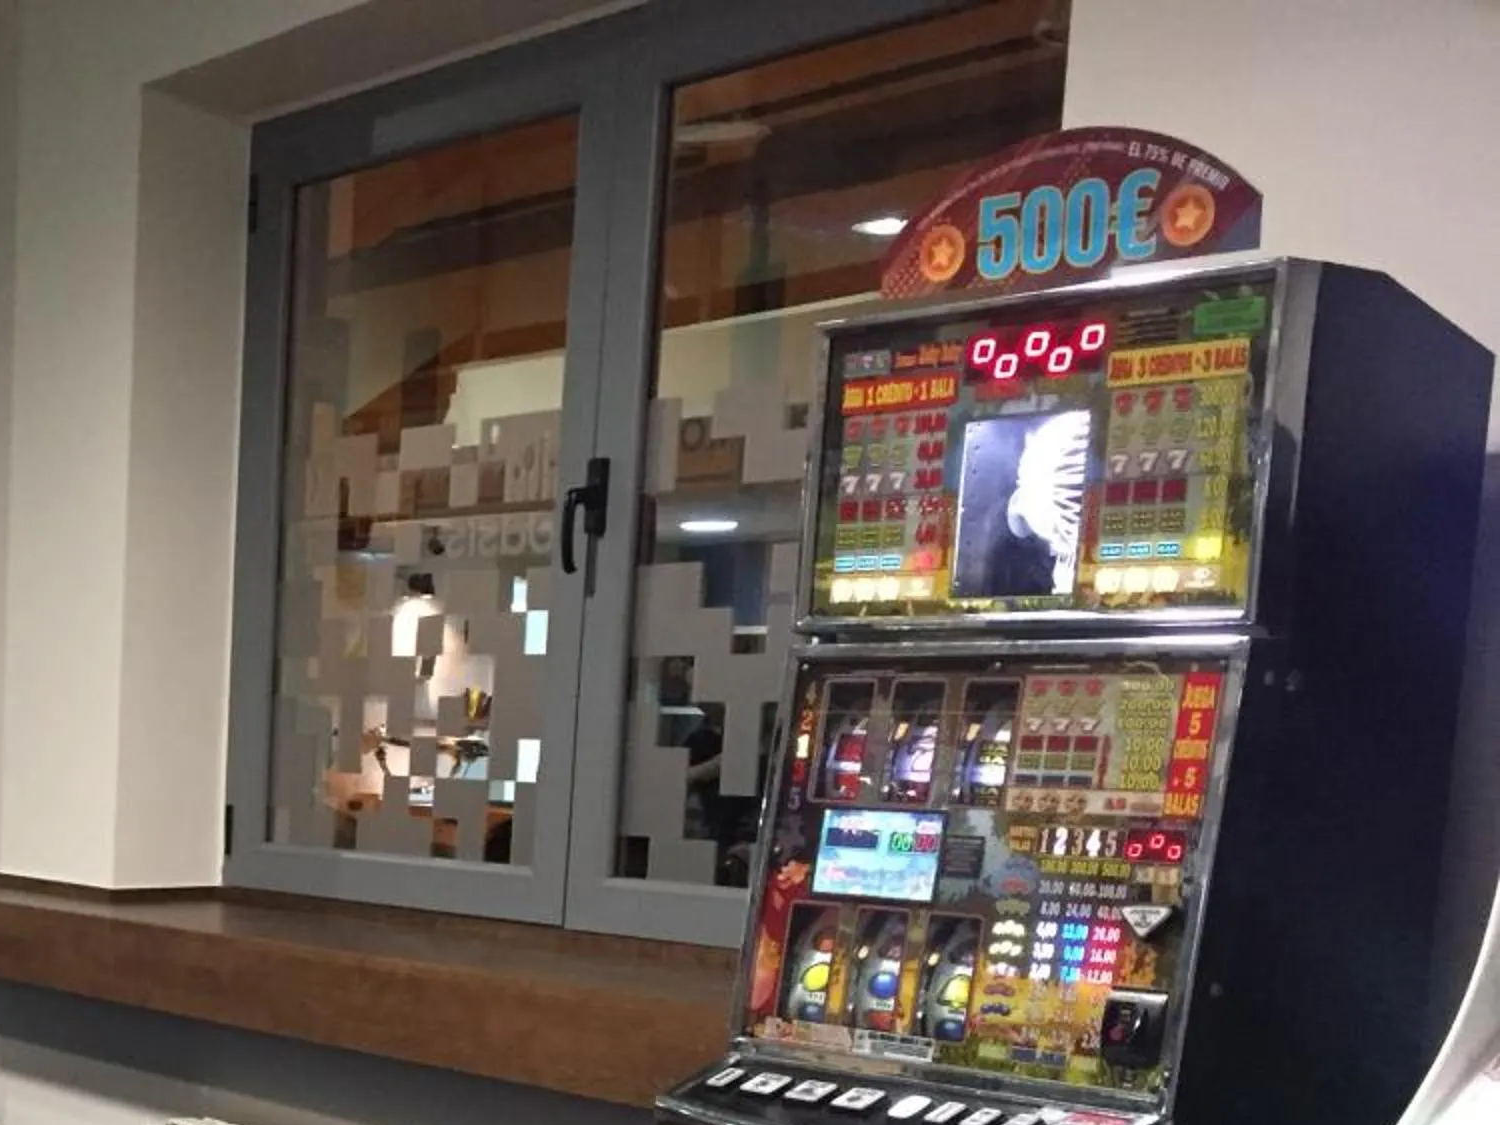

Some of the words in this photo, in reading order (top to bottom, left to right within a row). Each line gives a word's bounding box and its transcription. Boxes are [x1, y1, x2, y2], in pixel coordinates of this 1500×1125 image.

[1171, 151, 1189, 170] DE
[977, 167, 1162, 280] 500€
[1188, 712, 1203, 736] 5
[1053, 826, 1069, 857] 2
[1071, 827, 1085, 857] 3
[1086, 828, 1101, 857] 4
[1104, 829, 1119, 857] 5
